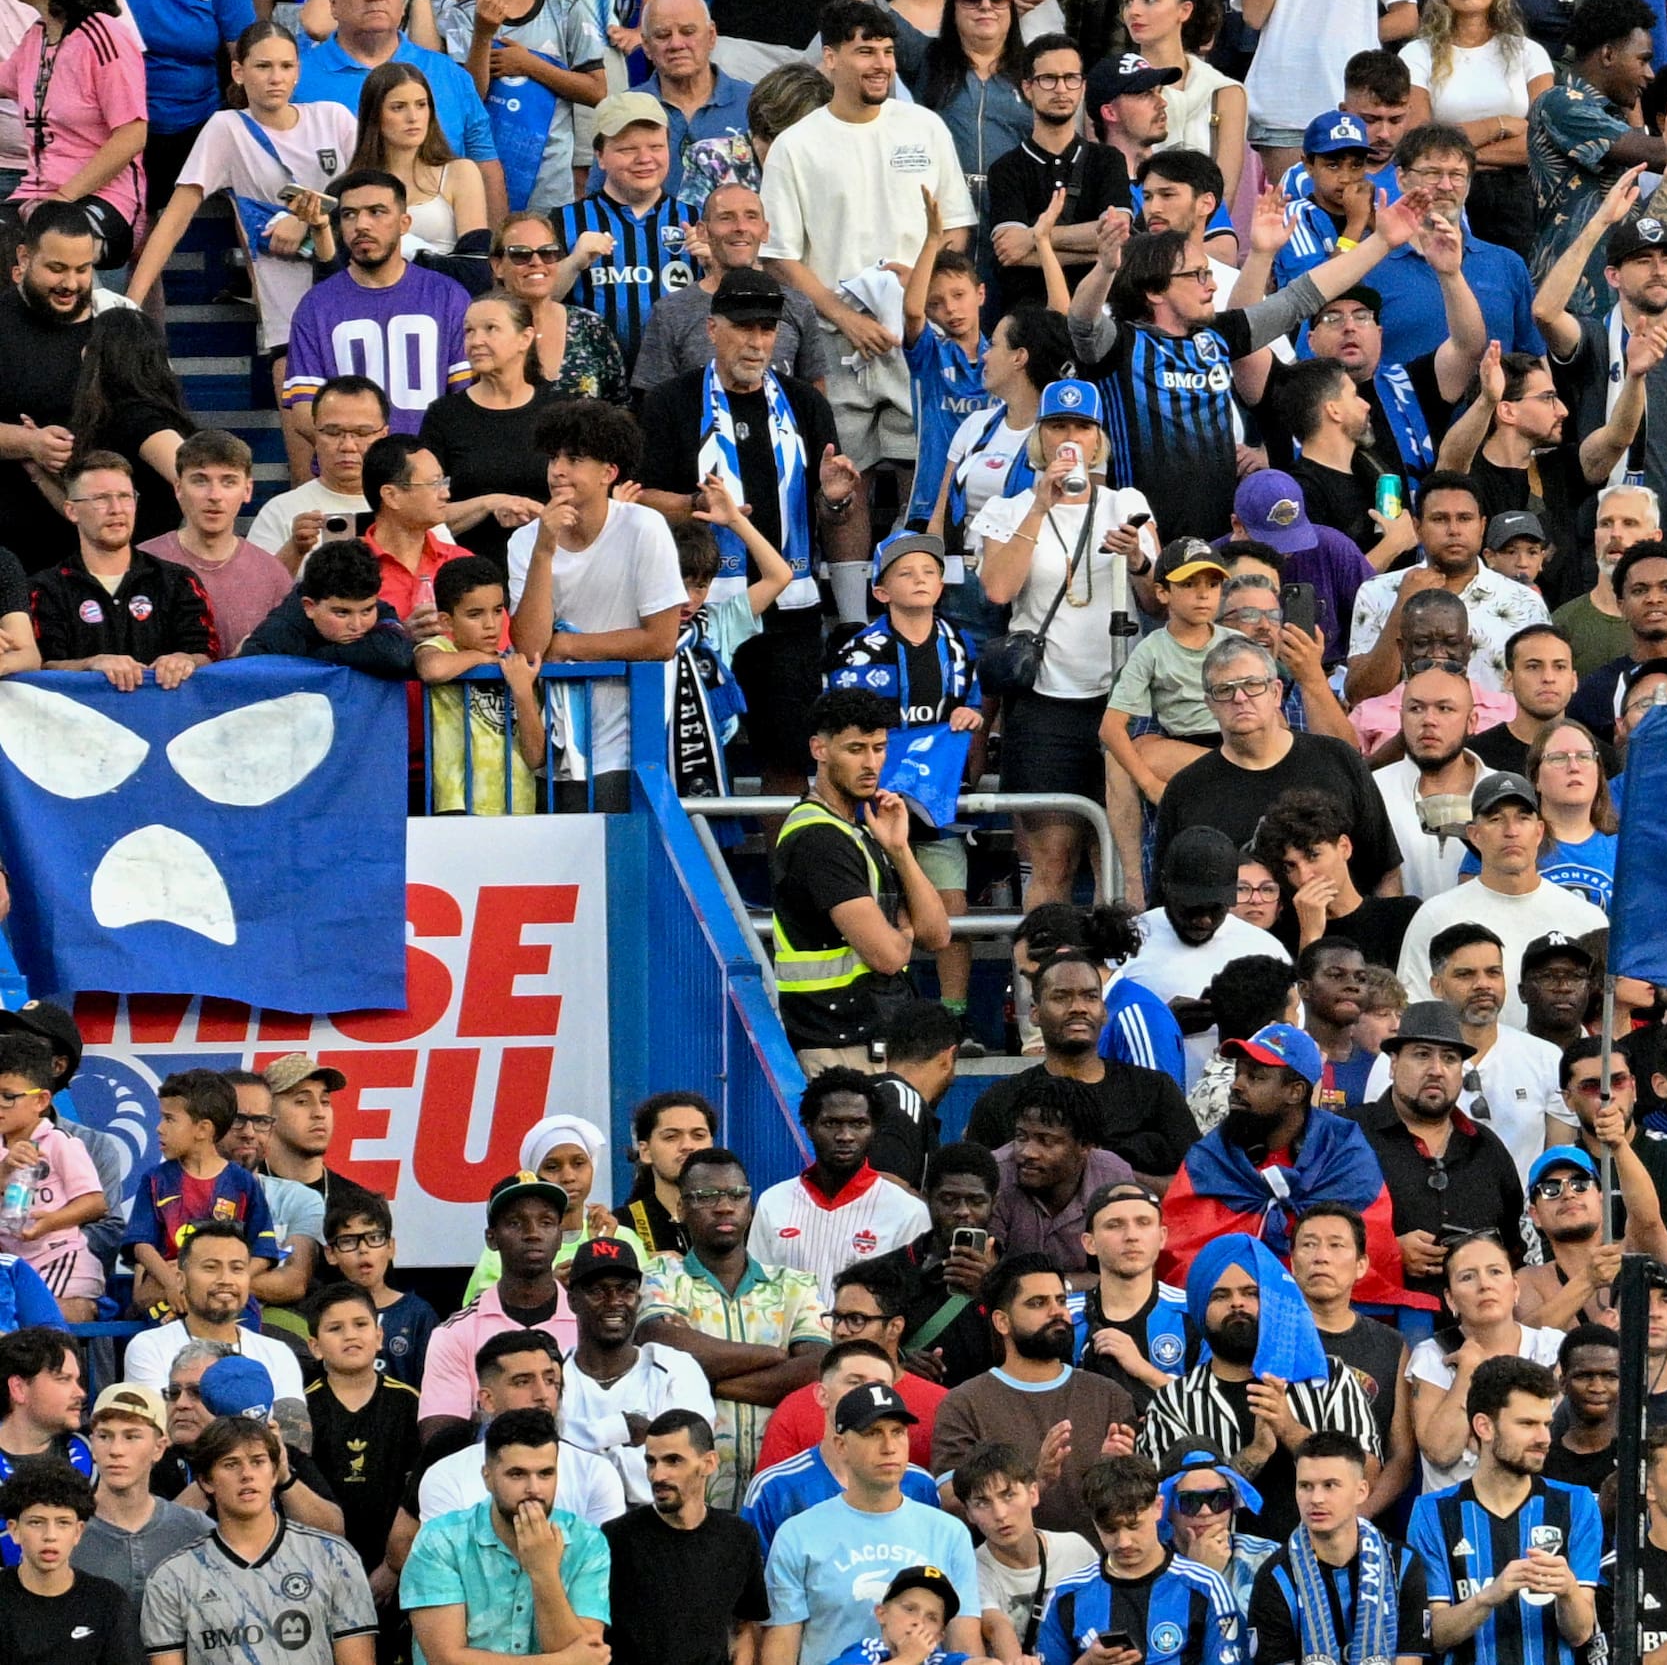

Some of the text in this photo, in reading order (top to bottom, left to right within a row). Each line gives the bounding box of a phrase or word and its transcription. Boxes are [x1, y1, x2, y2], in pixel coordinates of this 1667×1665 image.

[590, 265, 653, 286] BMO
[1163, 371, 1206, 390] BMO
[900, 705, 934, 722] MO
[592, 1241, 620, 1259] NY
[869, 1387, 893, 1406] L
[202, 1624, 264, 1650] BMO
